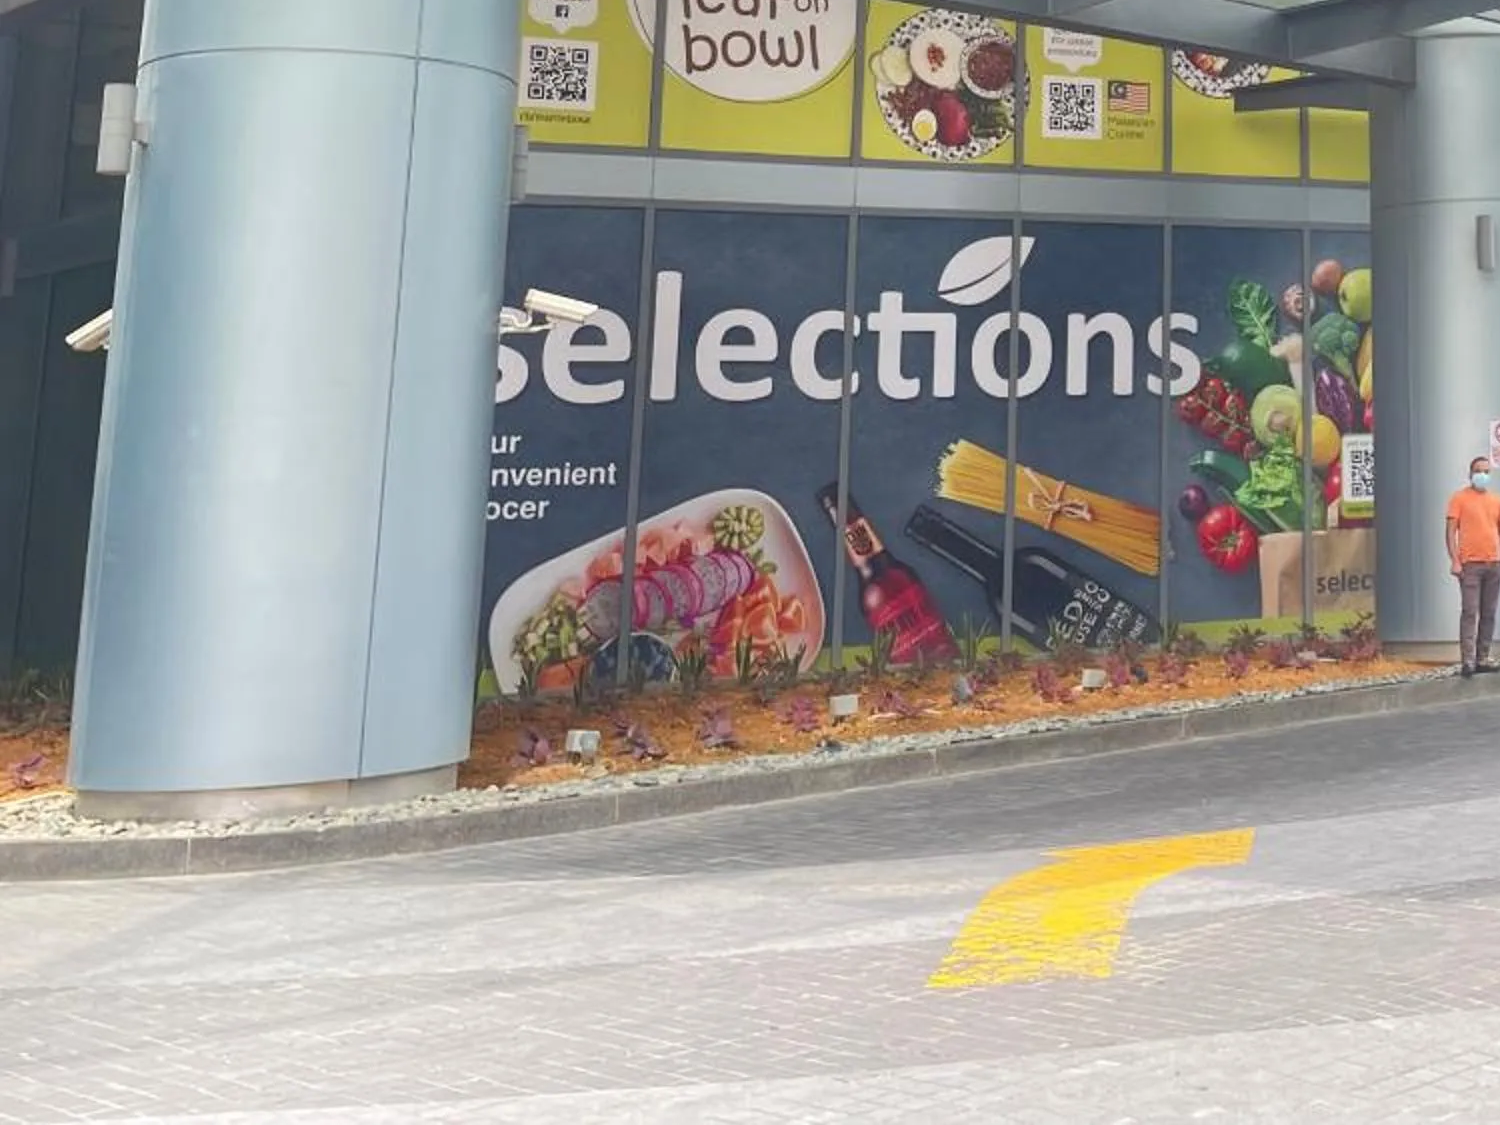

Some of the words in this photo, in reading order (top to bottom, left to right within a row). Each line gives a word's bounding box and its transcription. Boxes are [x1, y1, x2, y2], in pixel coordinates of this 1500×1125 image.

[681, 23, 820, 75] bowl
[490, 433, 523, 455] ur
[490, 461, 618, 488] nvenient
[485, 499, 551, 521] ocer
[1315, 570, 1373, 595] selec
